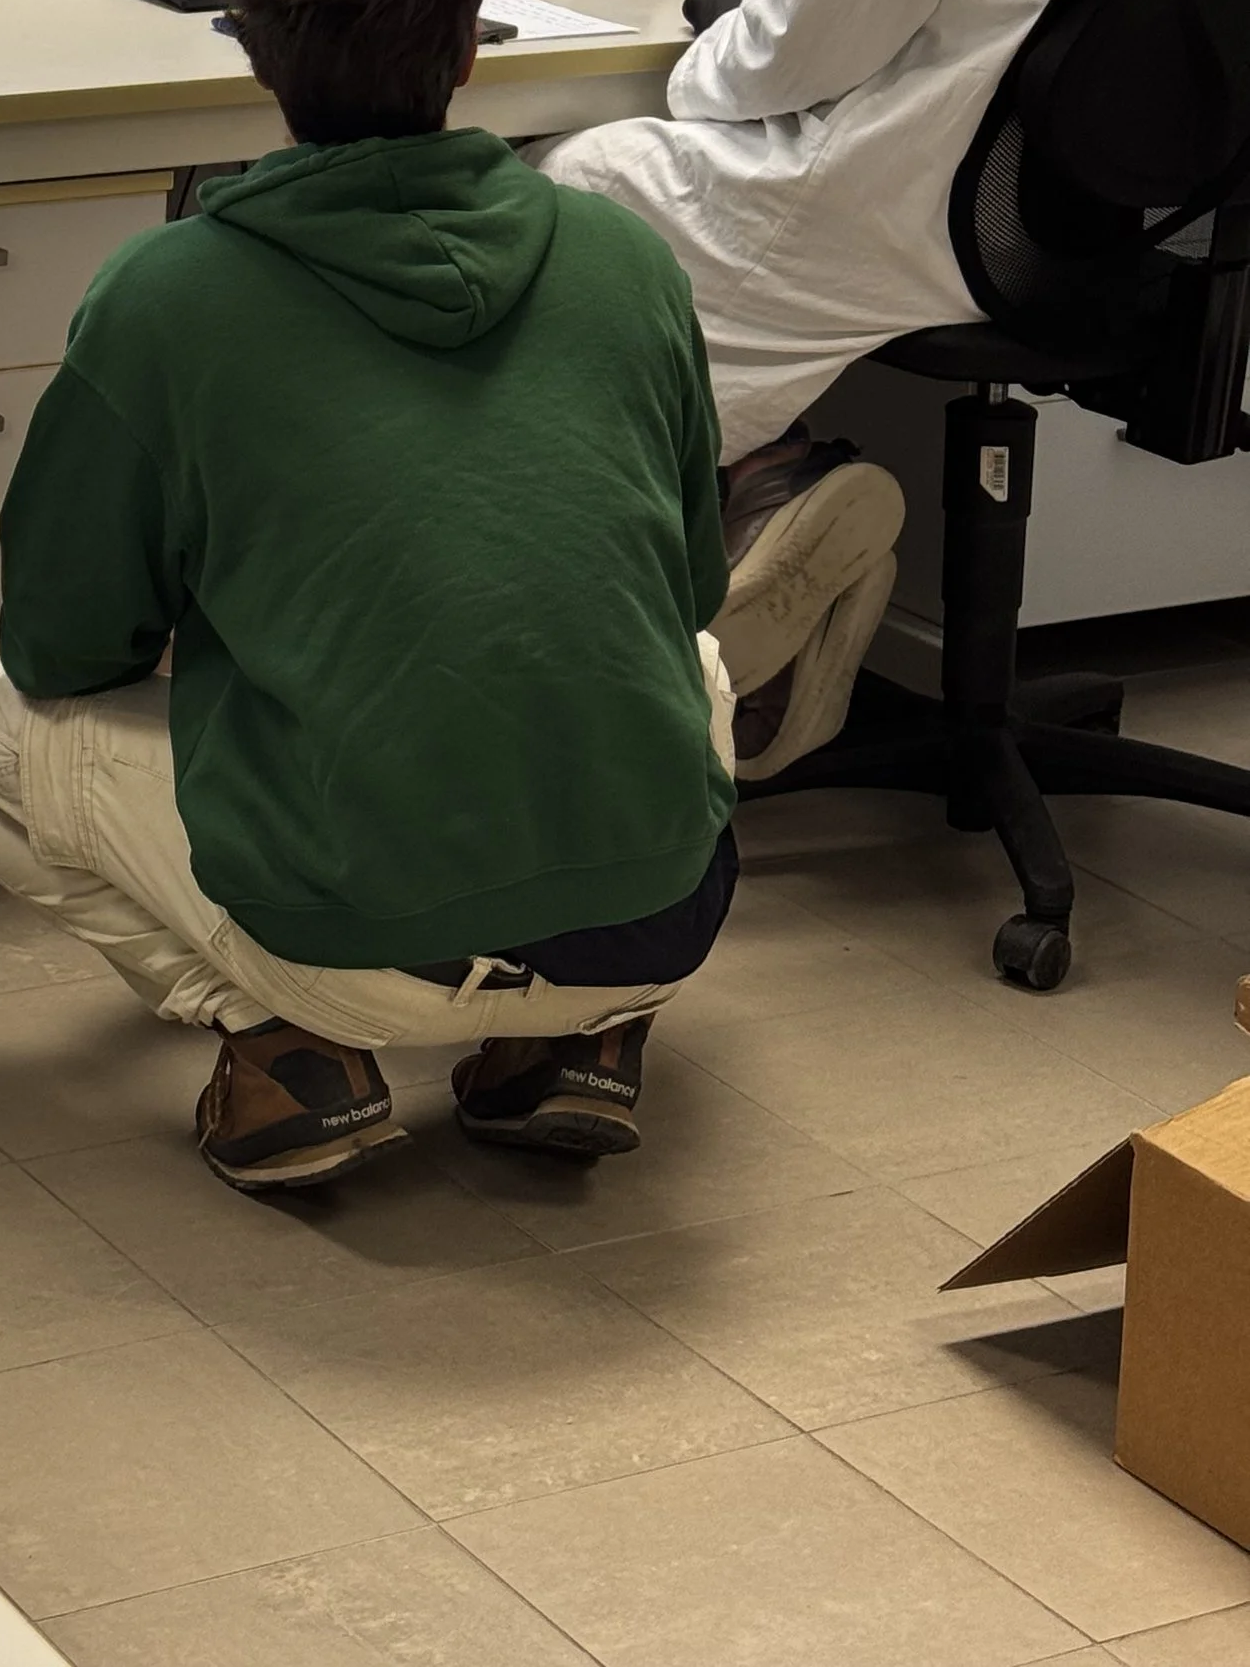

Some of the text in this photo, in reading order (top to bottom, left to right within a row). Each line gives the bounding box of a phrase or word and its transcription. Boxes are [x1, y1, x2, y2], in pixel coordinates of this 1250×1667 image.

[560, 1067, 587, 1083] new
[321, 1097, 390, 1128] new balanc
